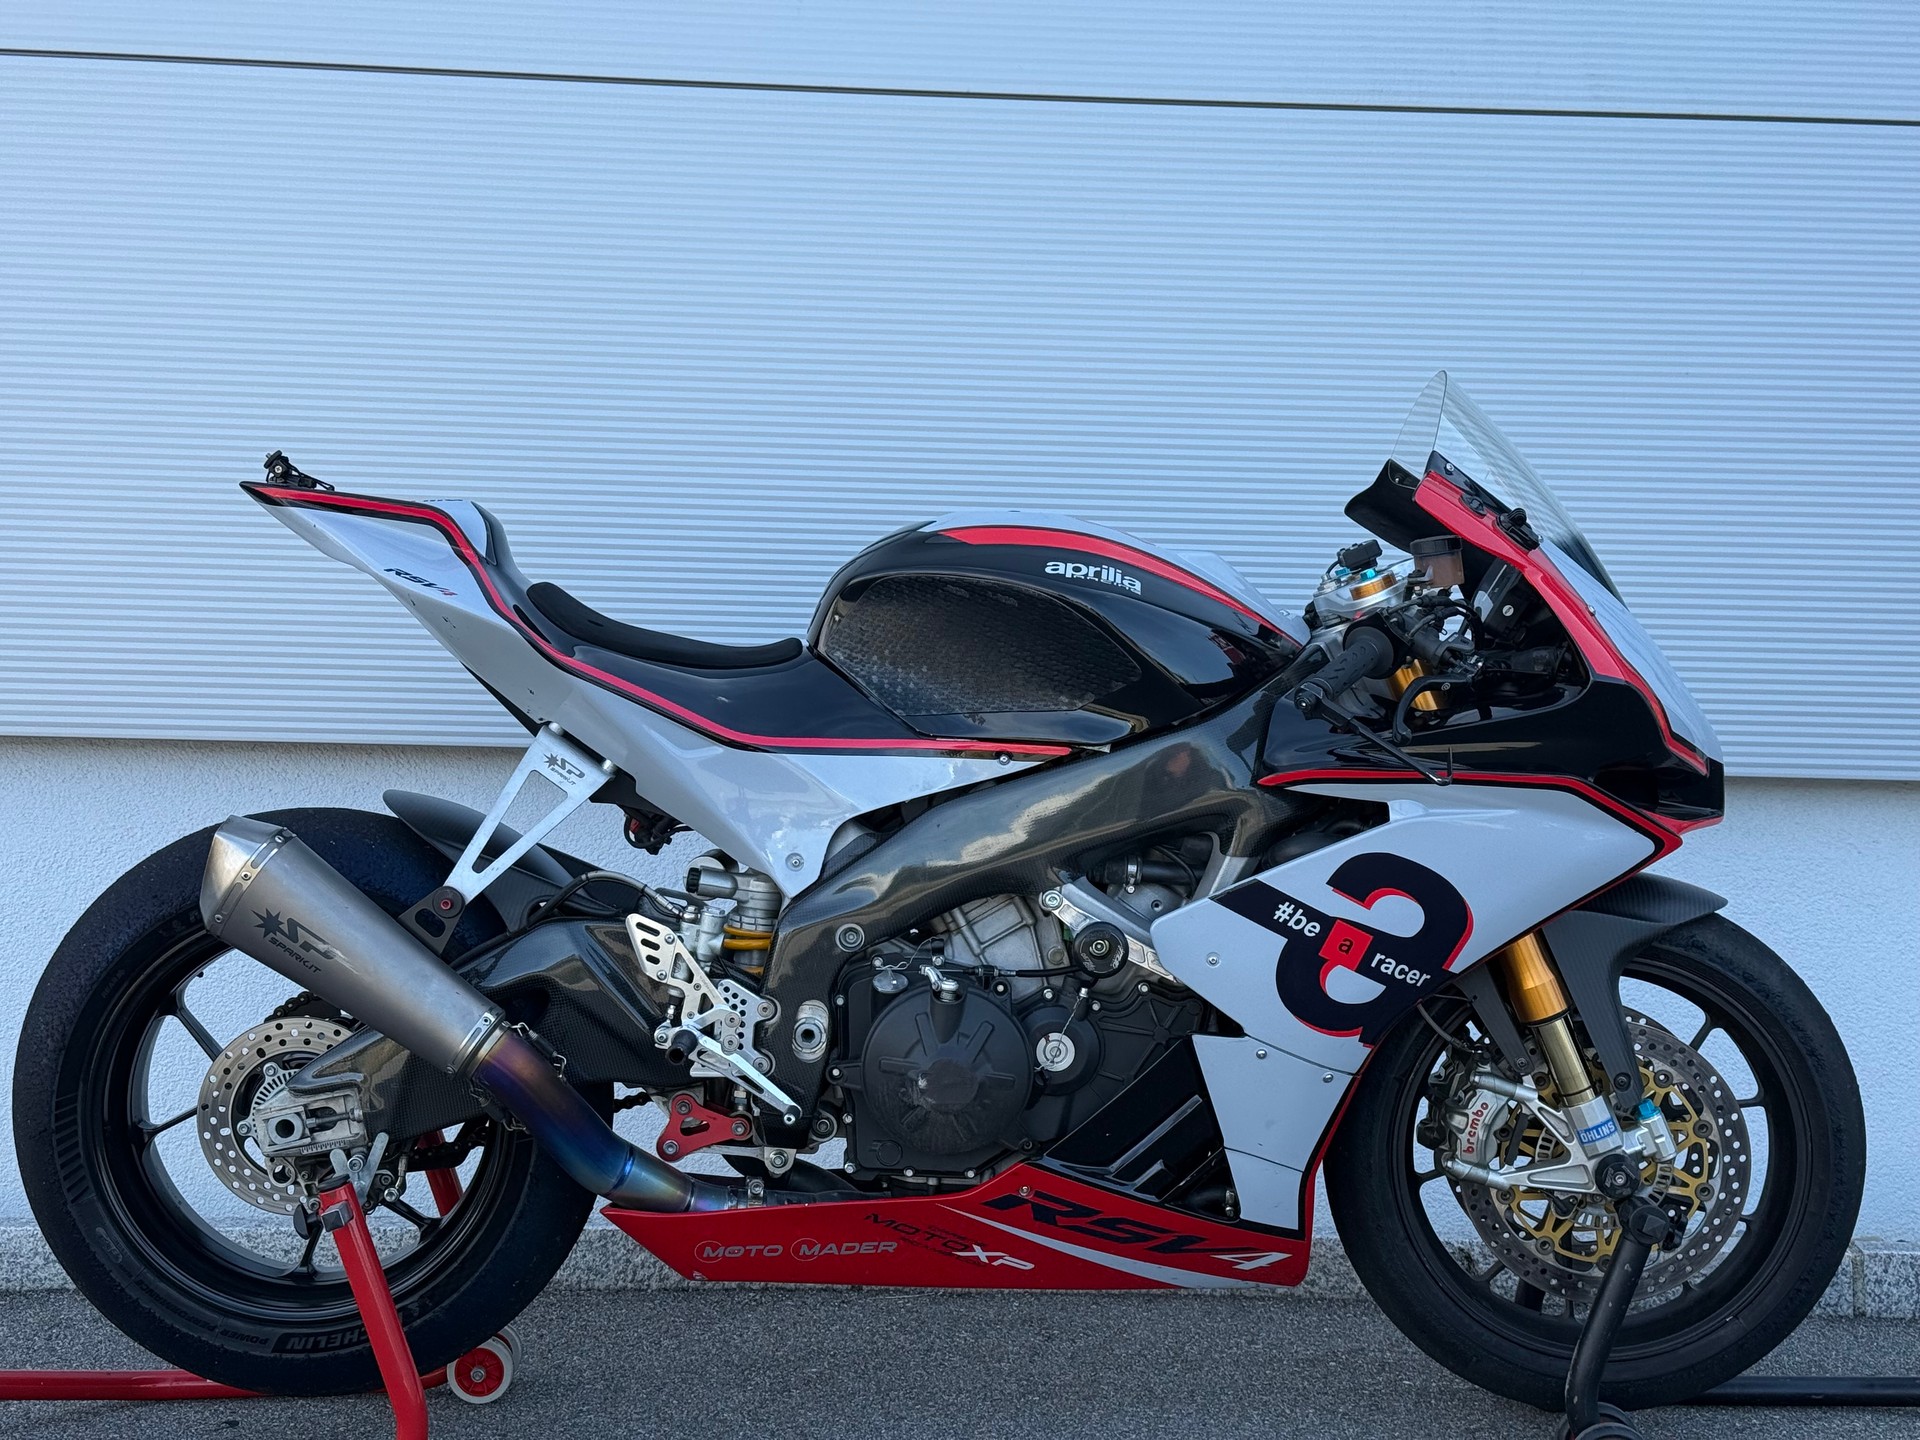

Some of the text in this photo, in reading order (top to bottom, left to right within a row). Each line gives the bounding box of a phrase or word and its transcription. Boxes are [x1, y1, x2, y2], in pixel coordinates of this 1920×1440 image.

[383, 568, 458, 596] RSV4
[1044, 561, 1142, 595] aprilia
[1272, 901, 1431, 988] #be a racer
[1462, 1101, 1490, 1155] brembo
[1579, 1118, 1616, 1145] ÖHLINS
[982, 1190, 1294, 1272] RSV4
[702, 1244, 784, 1258] MOTO
[798, 1241, 898, 1257] MADER
[220, 1328, 271, 1346] POWER
